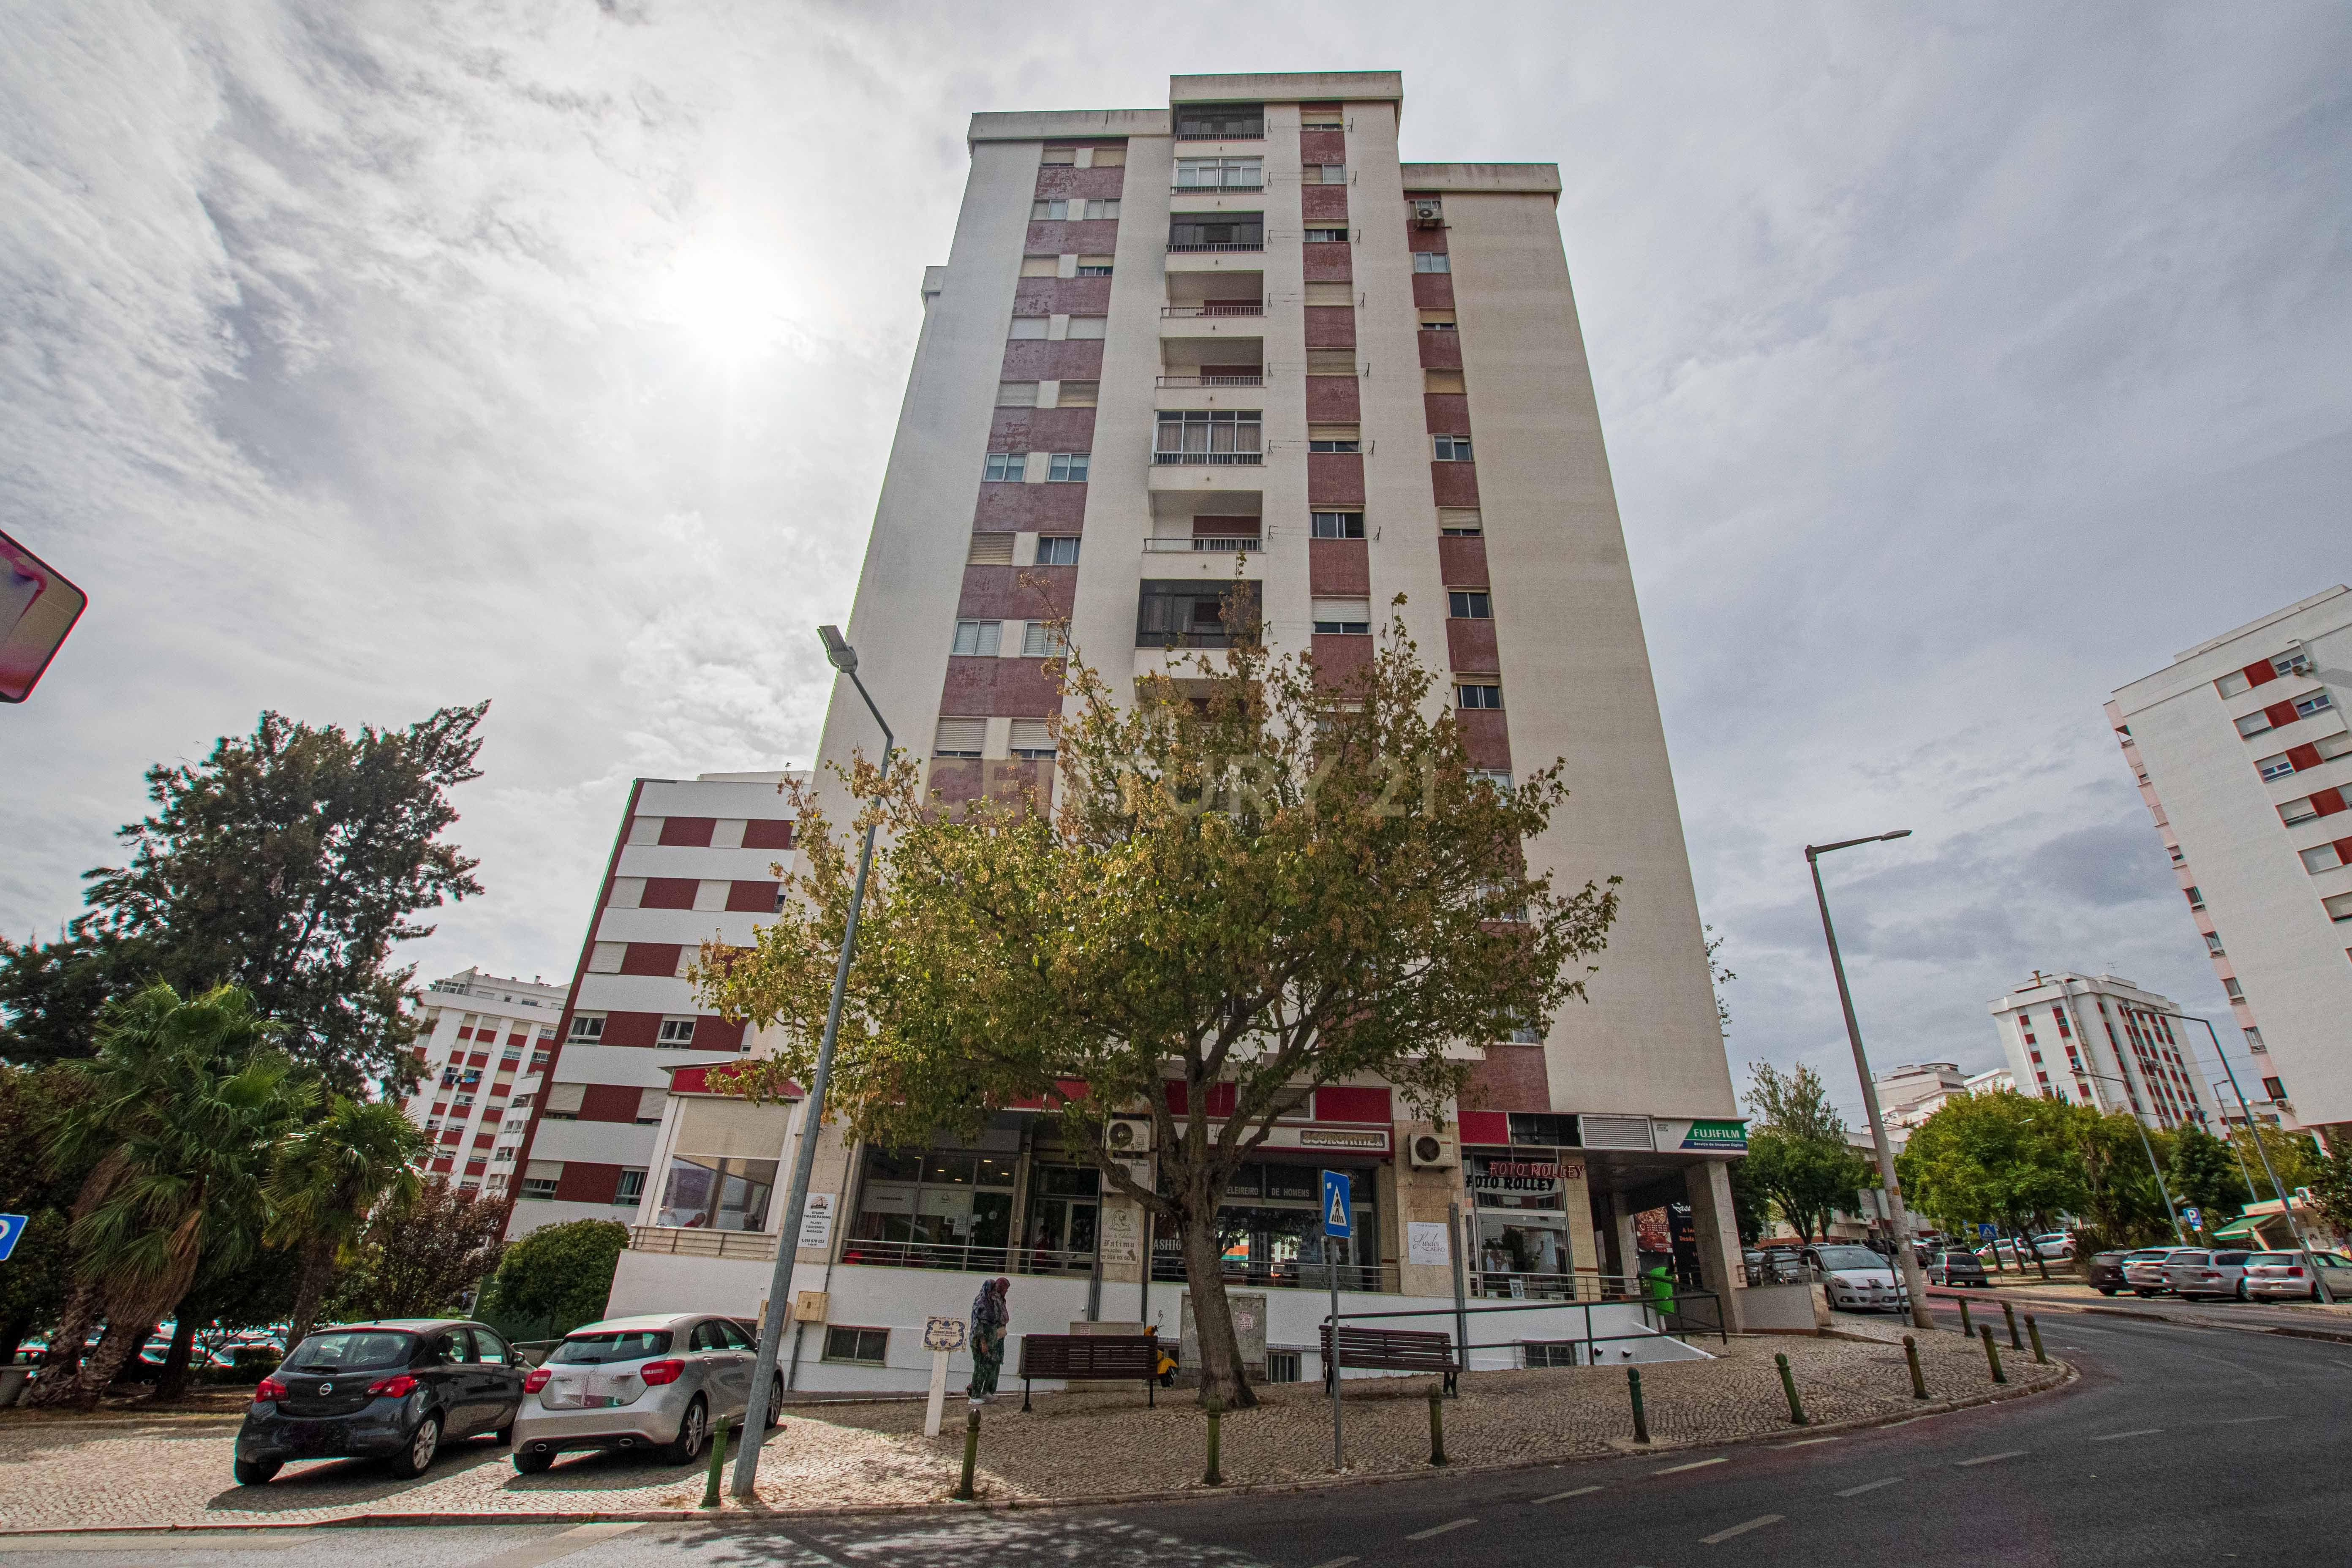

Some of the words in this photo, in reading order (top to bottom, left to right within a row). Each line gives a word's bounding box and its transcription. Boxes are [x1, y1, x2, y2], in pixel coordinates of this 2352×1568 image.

[1693, 1128, 1740, 1138] FUJIFILM
[1489, 1162, 1524, 1176] FOTO
[1530, 1162, 1584, 1178] ROLLEY
[1466, 1175, 1499, 1189] FOTO
[1503, 1176, 1555, 1191] ROLLEY
[1227, 1186, 1259, 1195] ELEIREIRO
[1271, 1187, 1280, 1196] DE
[1284, 1188, 1309, 1197] HOMENS
[2188, 1209, 2197, 1222] P
[1153, 1239, 1181, 1251] ASHIO
